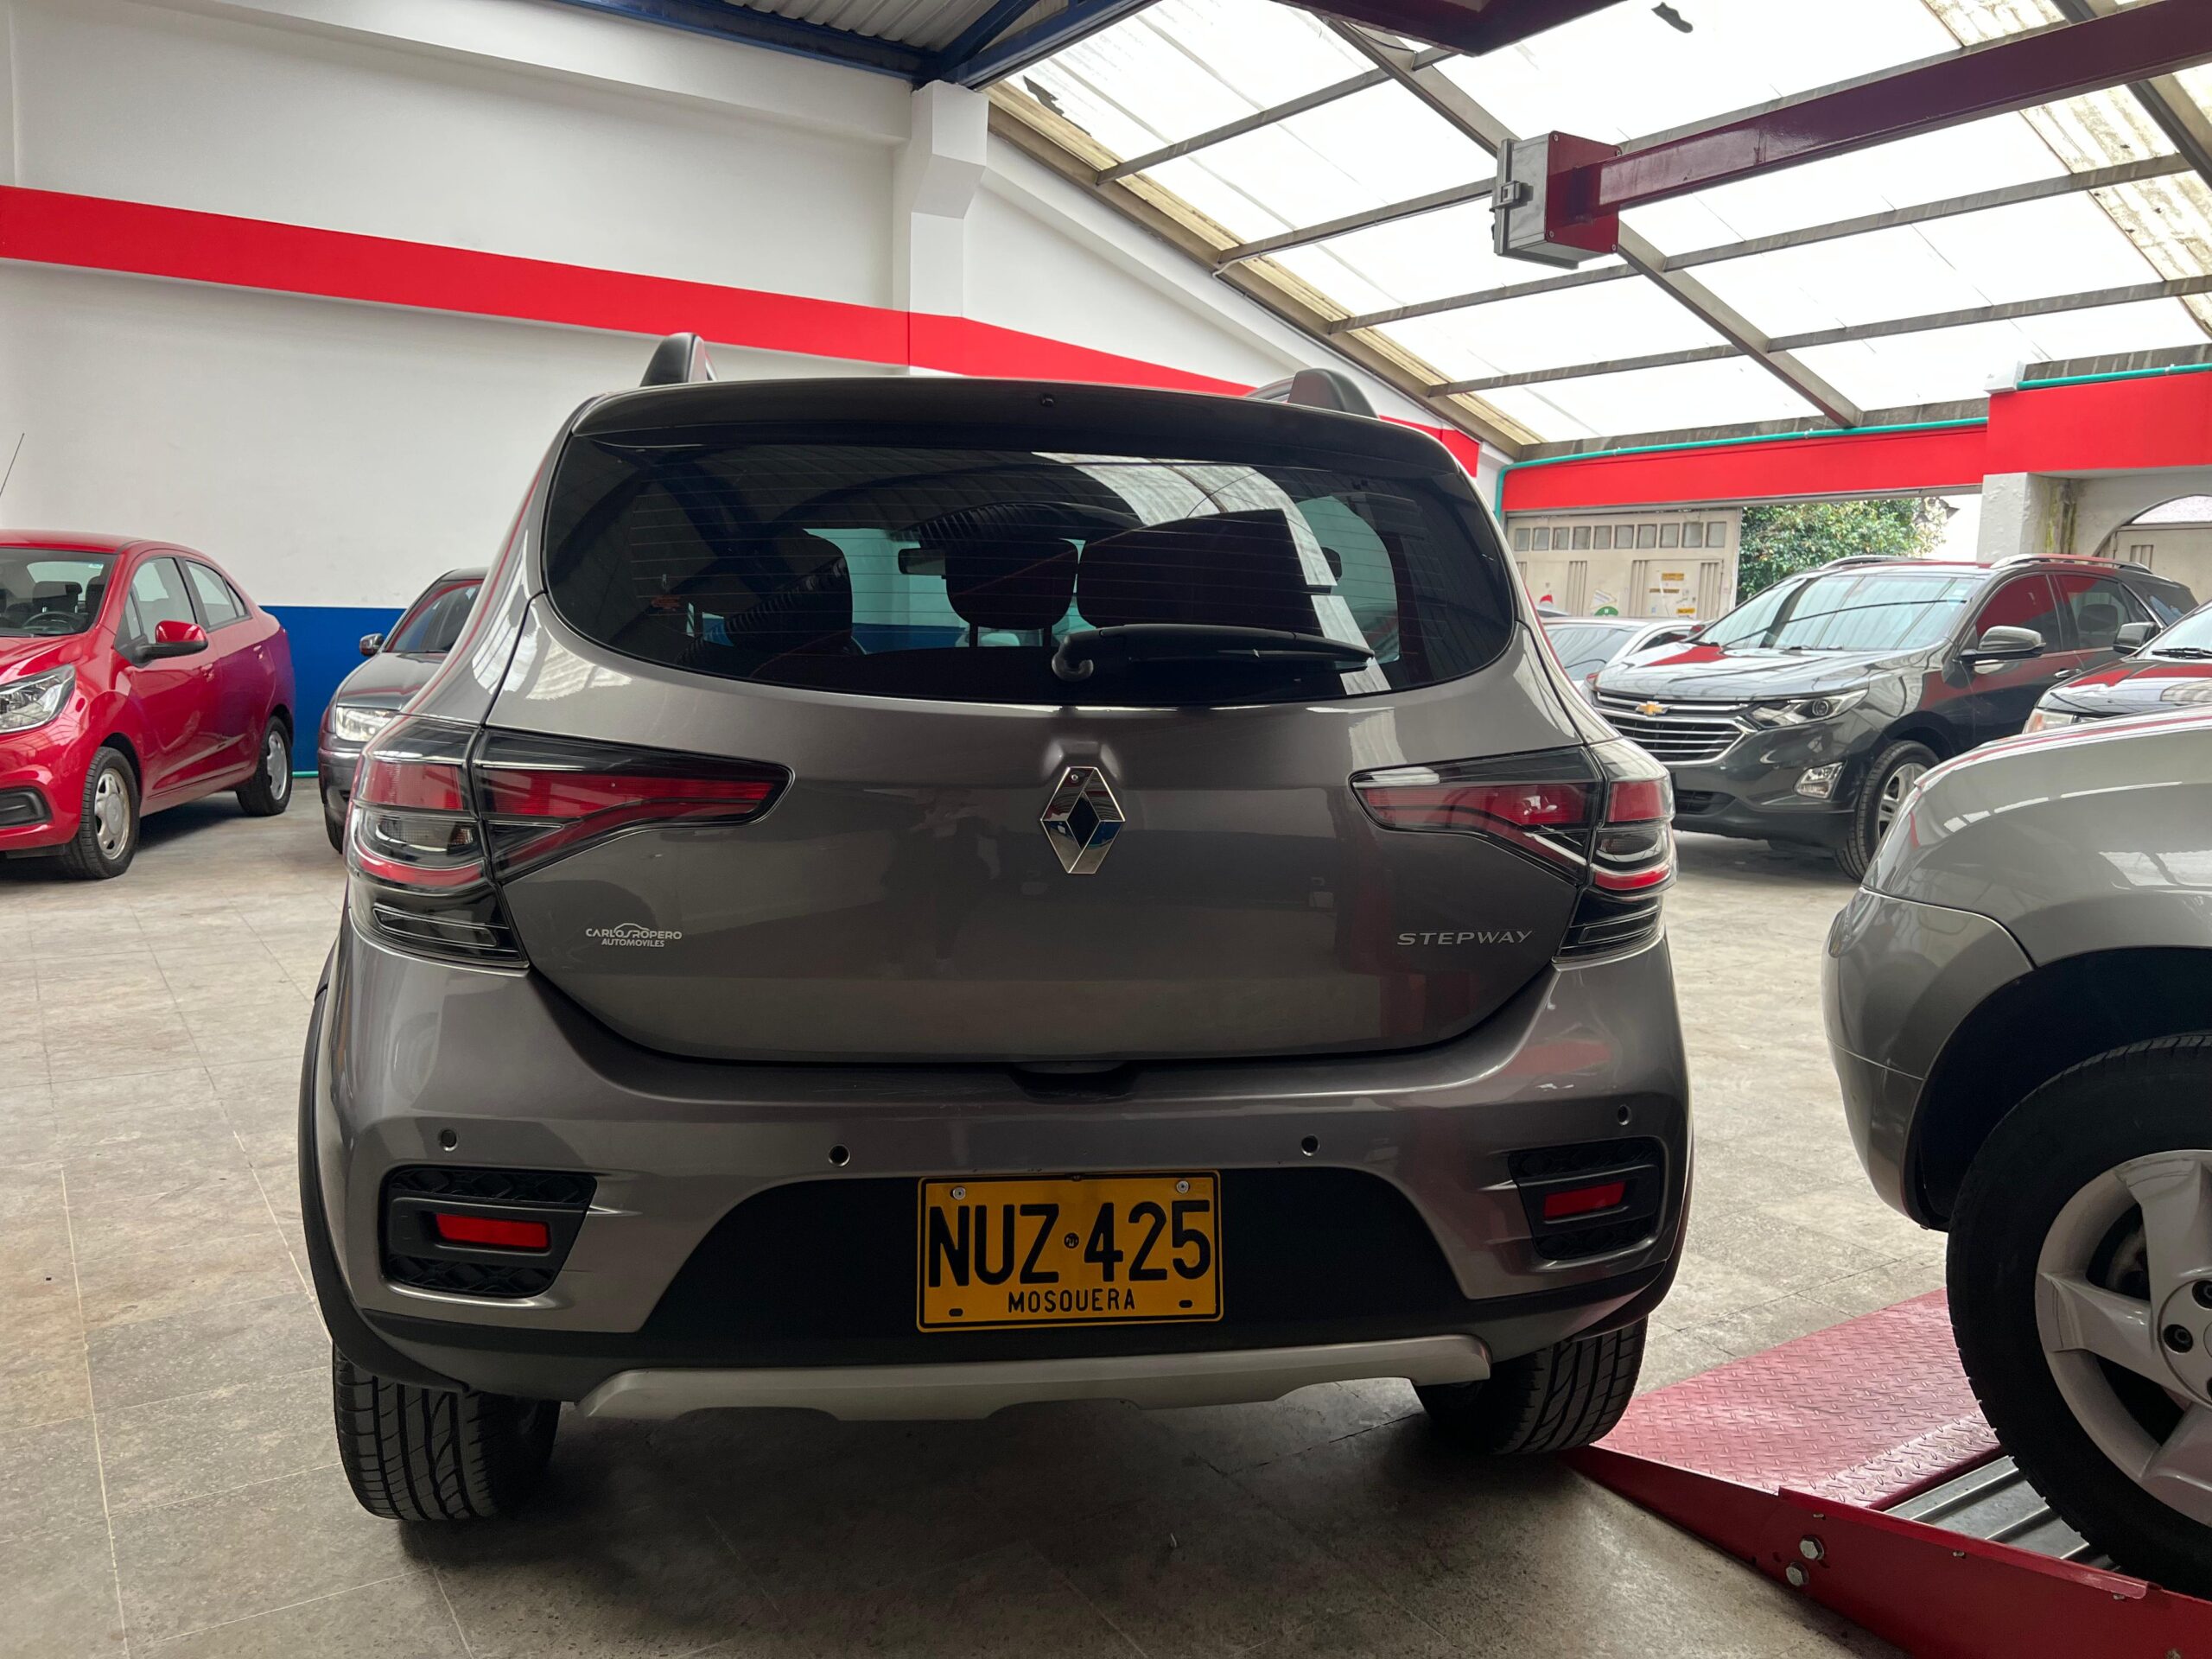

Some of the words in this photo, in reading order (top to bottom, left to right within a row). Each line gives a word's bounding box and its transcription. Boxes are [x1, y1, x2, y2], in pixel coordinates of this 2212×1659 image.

[601, 938, 665, 947] AUTOMOVILES
[1396, 930, 1533, 945] STEPWAY
[929, 1204, 1059, 1287] NUZ
[1084, 1199, 1211, 1281] 425
[1007, 1288, 1135, 1313] MOSQUERA
